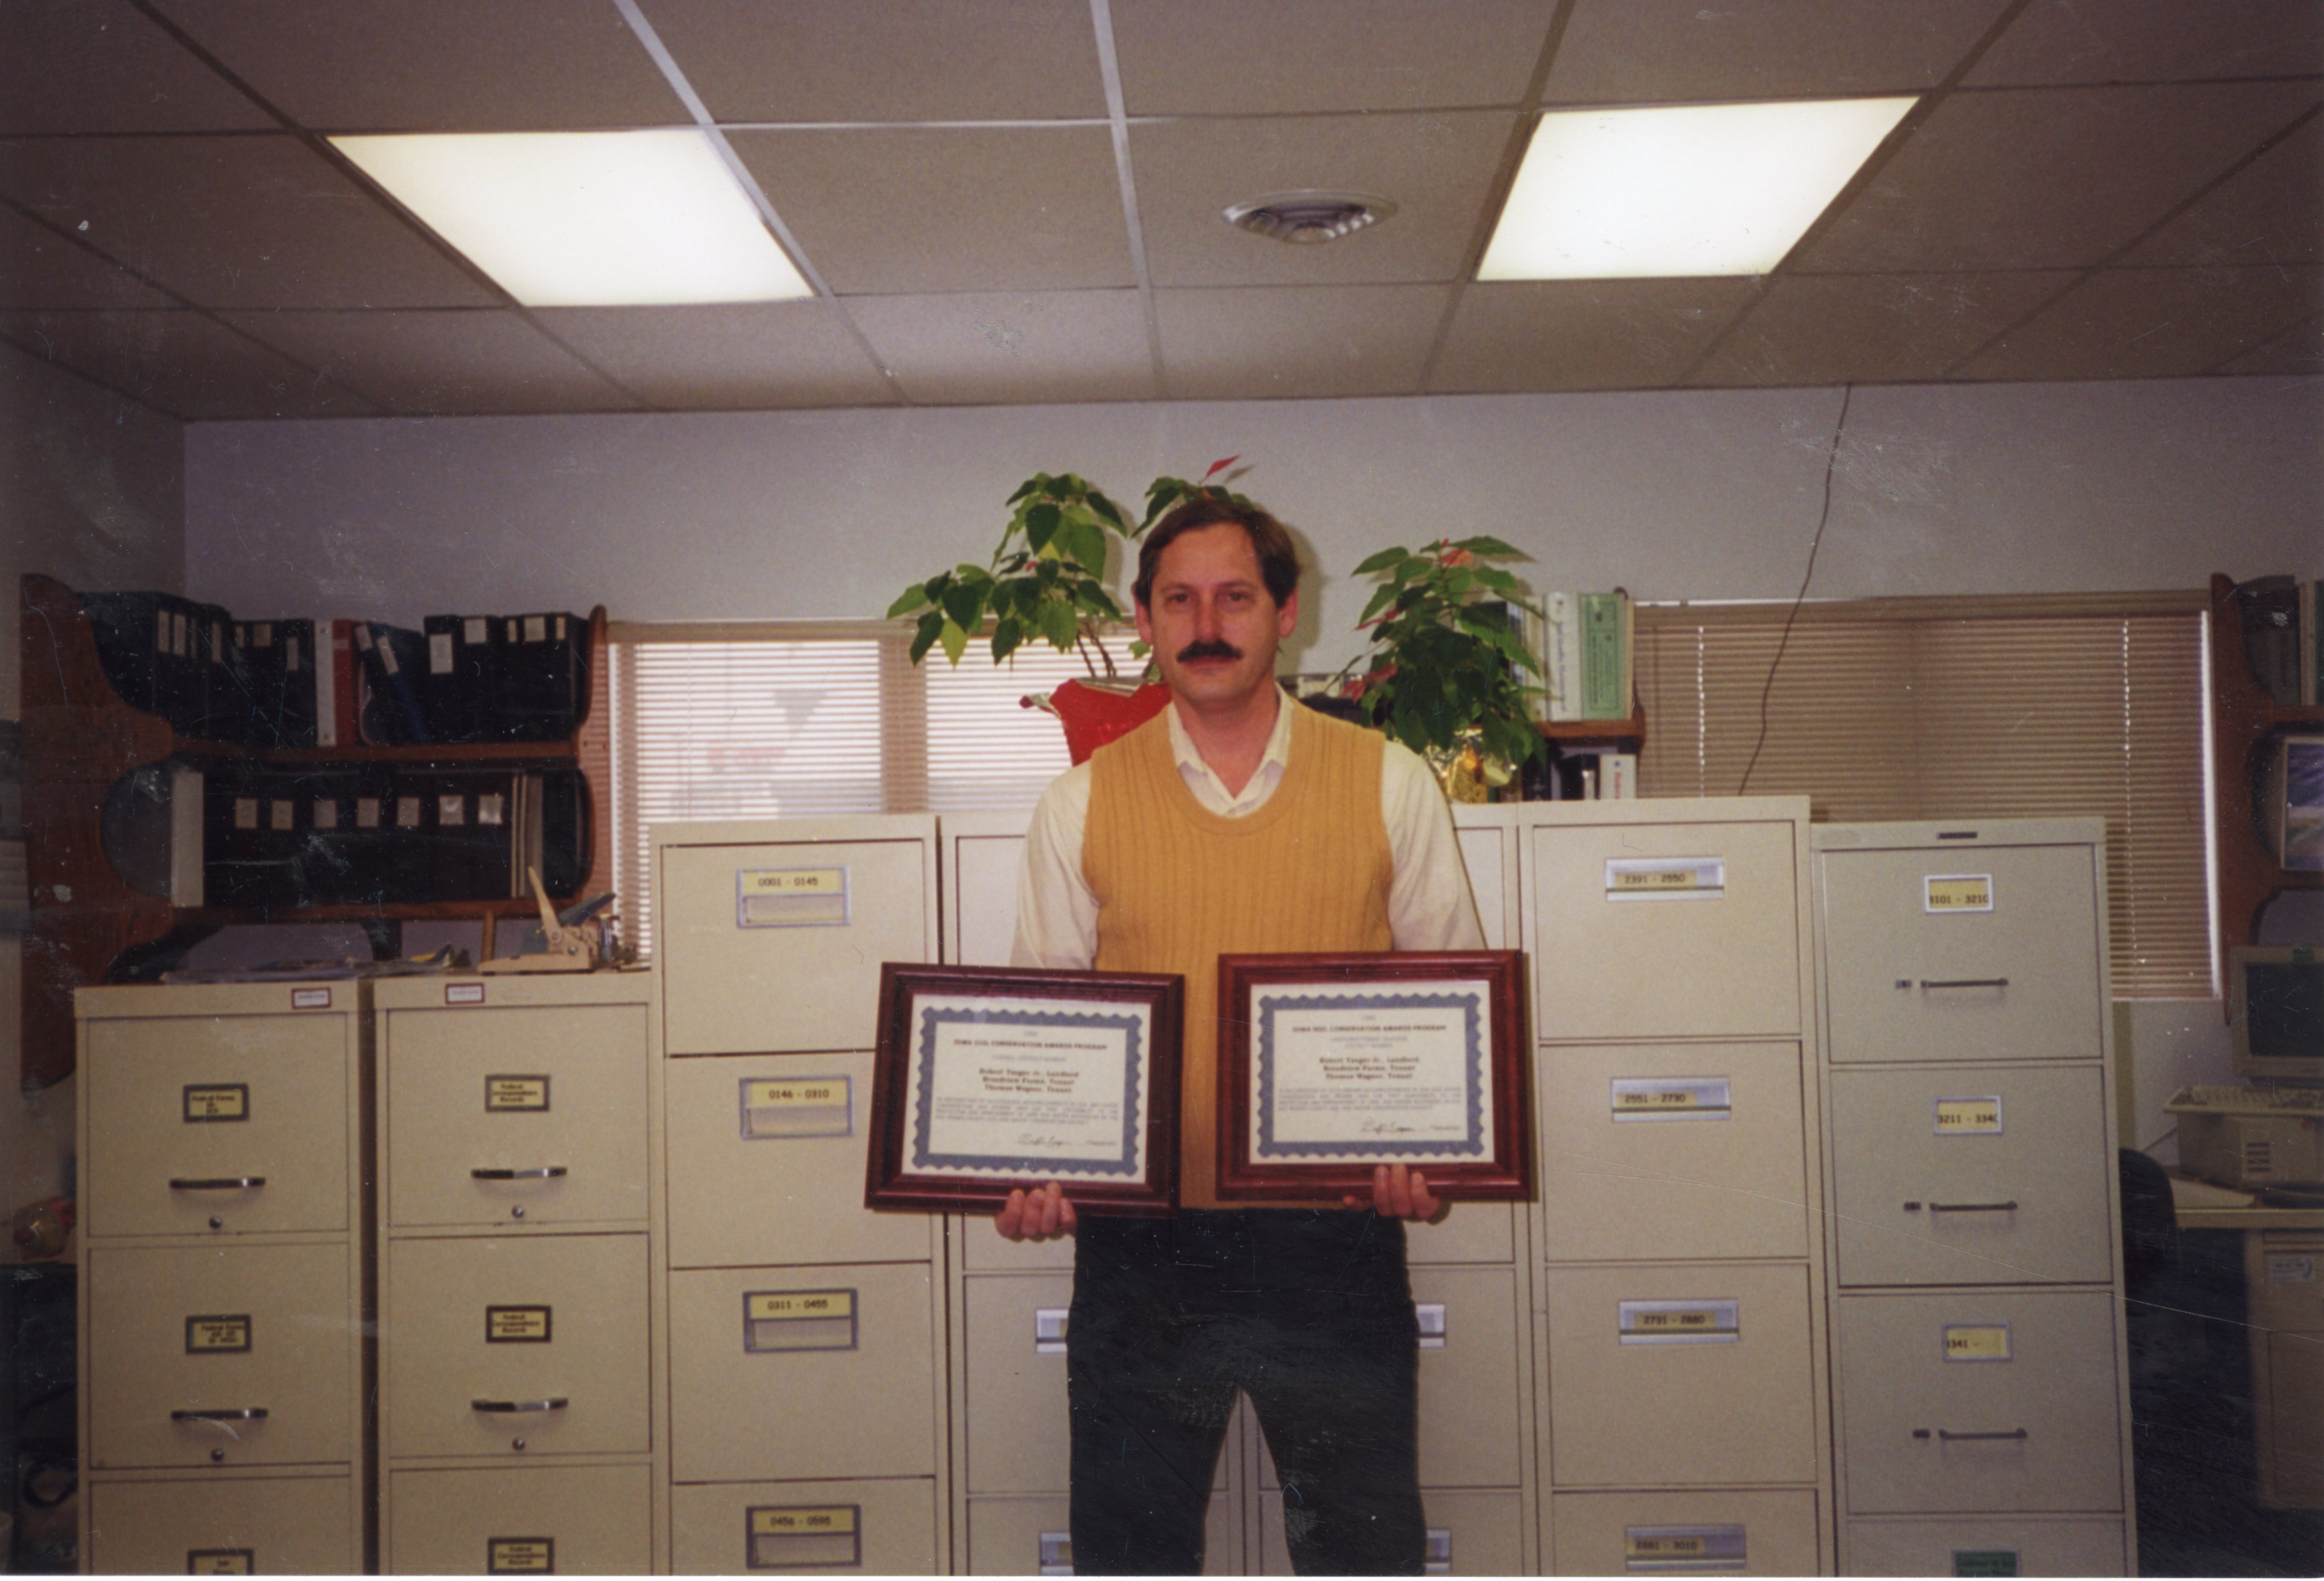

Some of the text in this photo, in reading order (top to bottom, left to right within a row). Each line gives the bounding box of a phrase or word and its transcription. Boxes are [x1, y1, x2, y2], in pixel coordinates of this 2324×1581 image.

[757, 877, 782, 887] 0001
[794, 876, 818, 886] 0145
[1624, 875, 1648, 884] 2391
[769, 1090, 793, 1100] 0146
[804, 1089, 830, 1098] 0310
[1660, 1093, 1687, 1103] 2730
[767, 1300, 792, 1310] 0311
